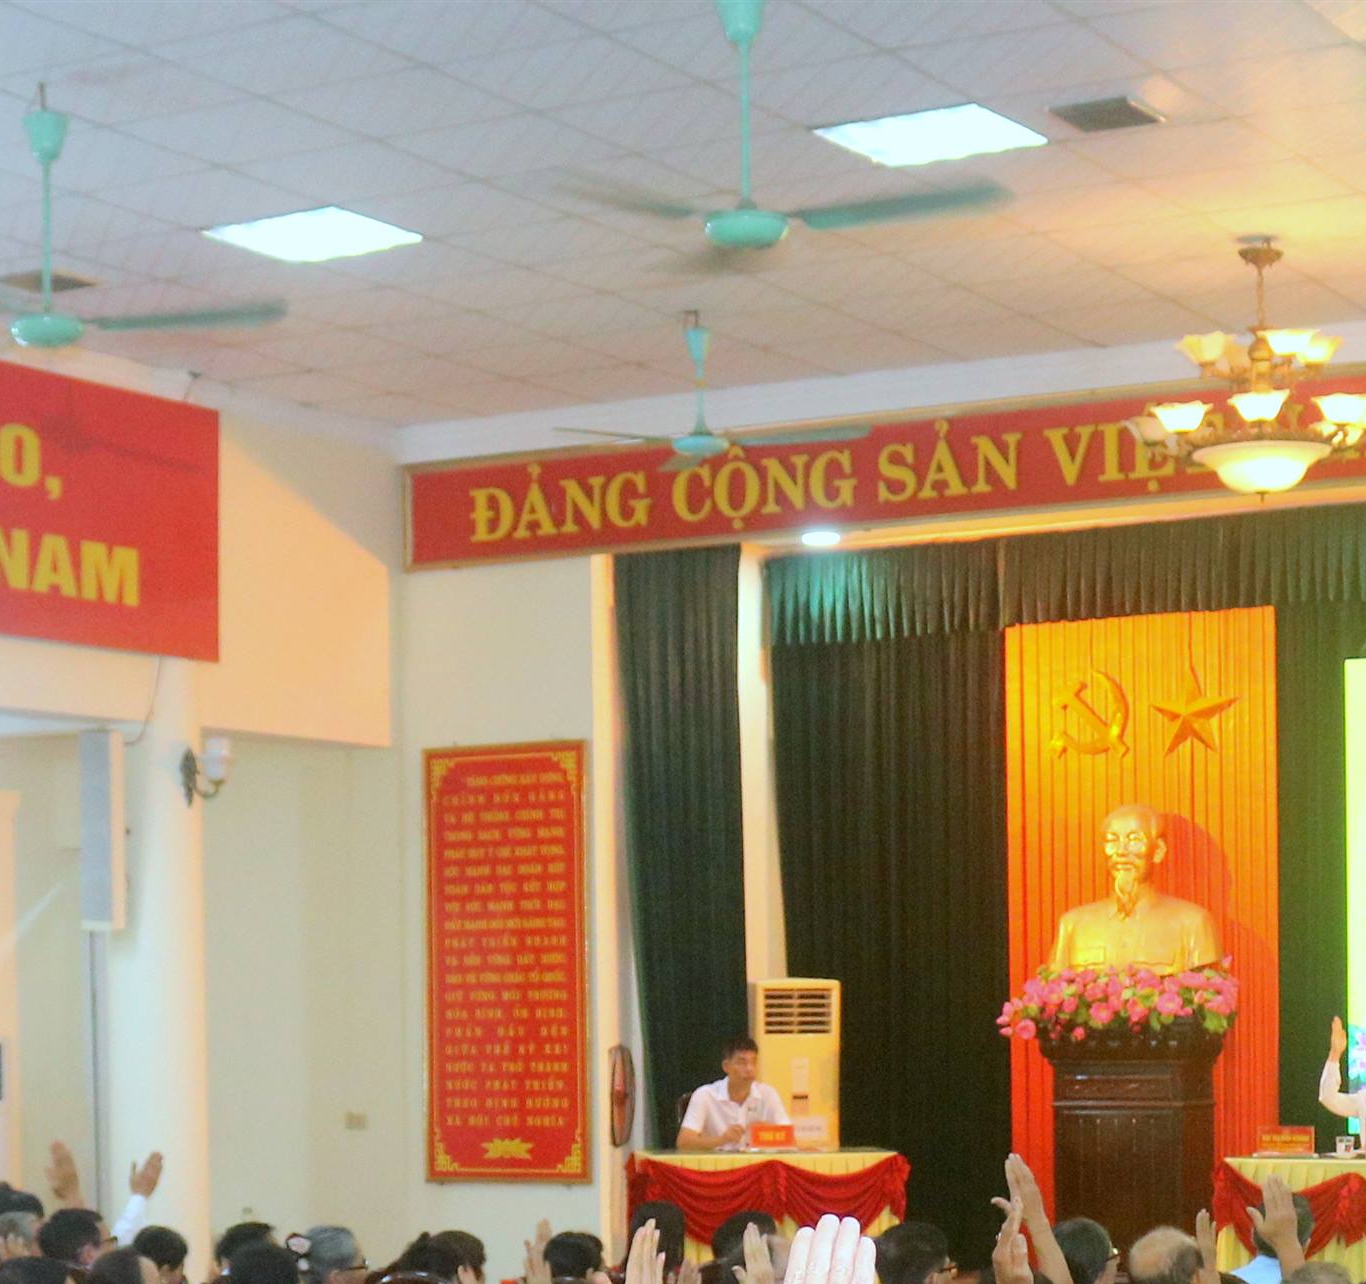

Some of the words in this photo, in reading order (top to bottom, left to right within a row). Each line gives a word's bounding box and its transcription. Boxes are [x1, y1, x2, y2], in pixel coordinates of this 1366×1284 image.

[468, 463, 652, 543] ĐẢNG
[671, 445, 858, 530] CỘNG
[877, 419, 1023, 504] SẢN
